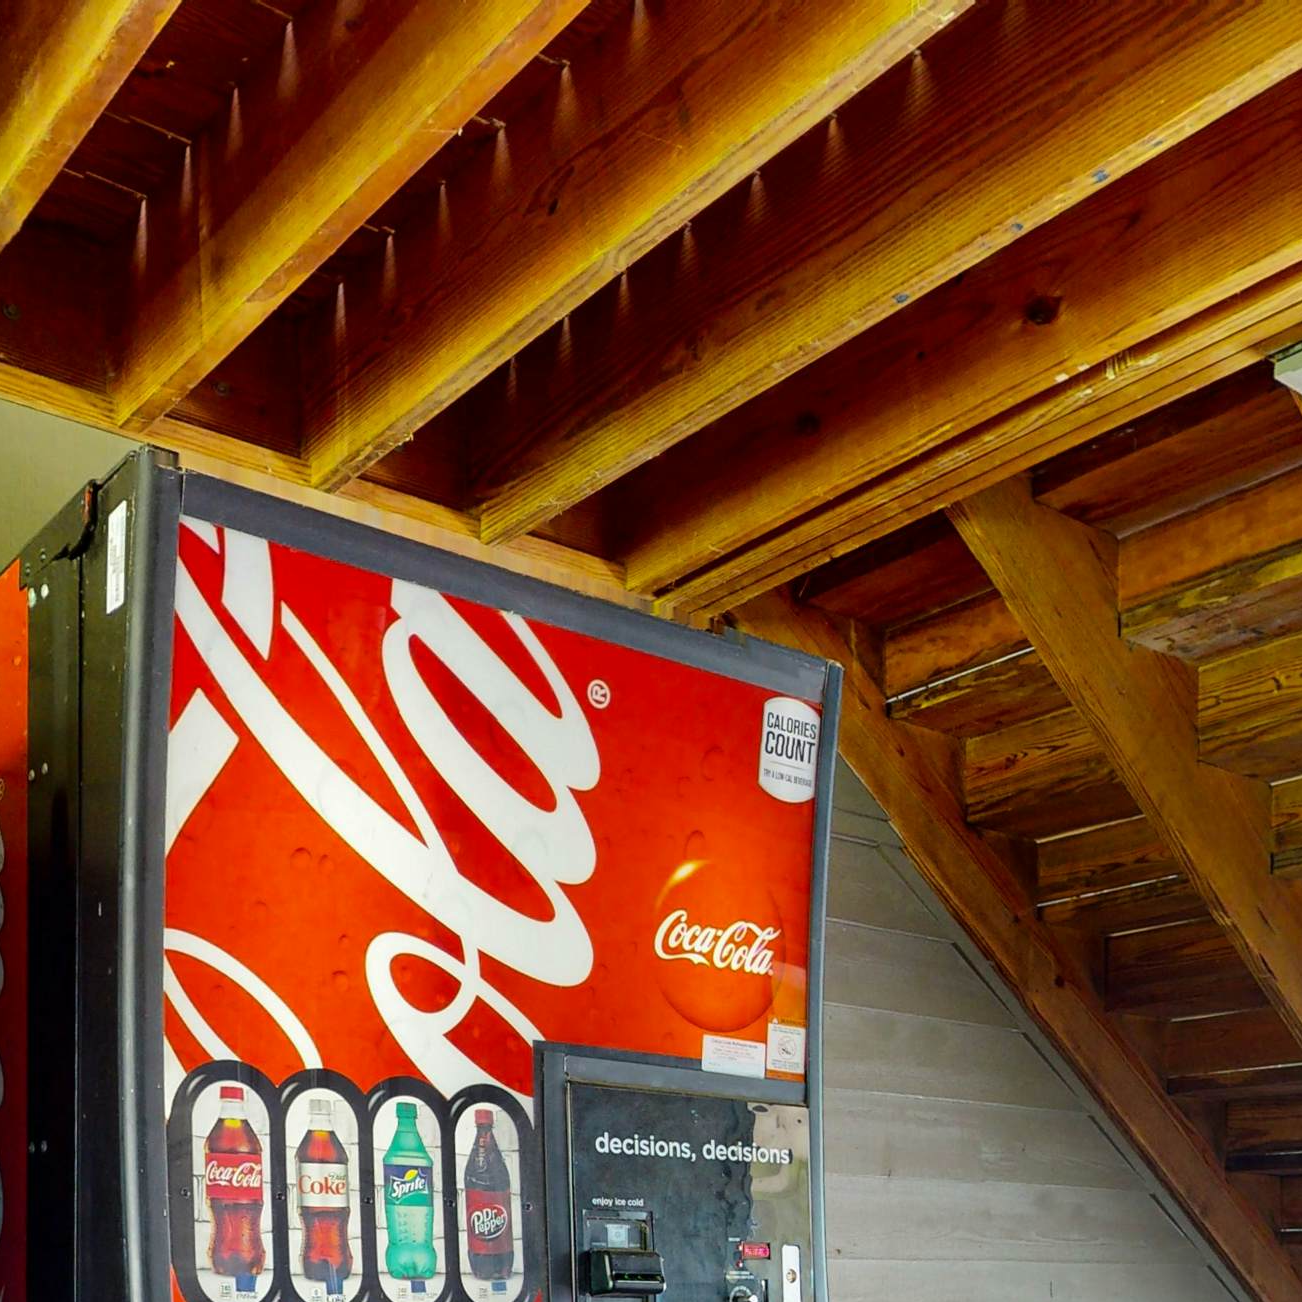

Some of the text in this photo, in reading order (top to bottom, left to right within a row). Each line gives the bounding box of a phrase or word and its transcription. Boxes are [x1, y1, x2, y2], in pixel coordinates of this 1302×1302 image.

[767, 711, 817, 740] CALORIES
[764, 731, 816, 764] COUNT
[654, 909, 782, 976] Coca-Cola
[594, 1131, 791, 1165] decisions, decisions
[205, 1160, 262, 1188] Coca-Cola
[298, 1174, 347, 1195] Coke
[391, 1177, 426, 1199] Sprite
[482, 1207, 498, 1221] Dr
[591, 1196, 644, 1207] enjoy ice cold
[473, 1210, 506, 1235] Pepper
